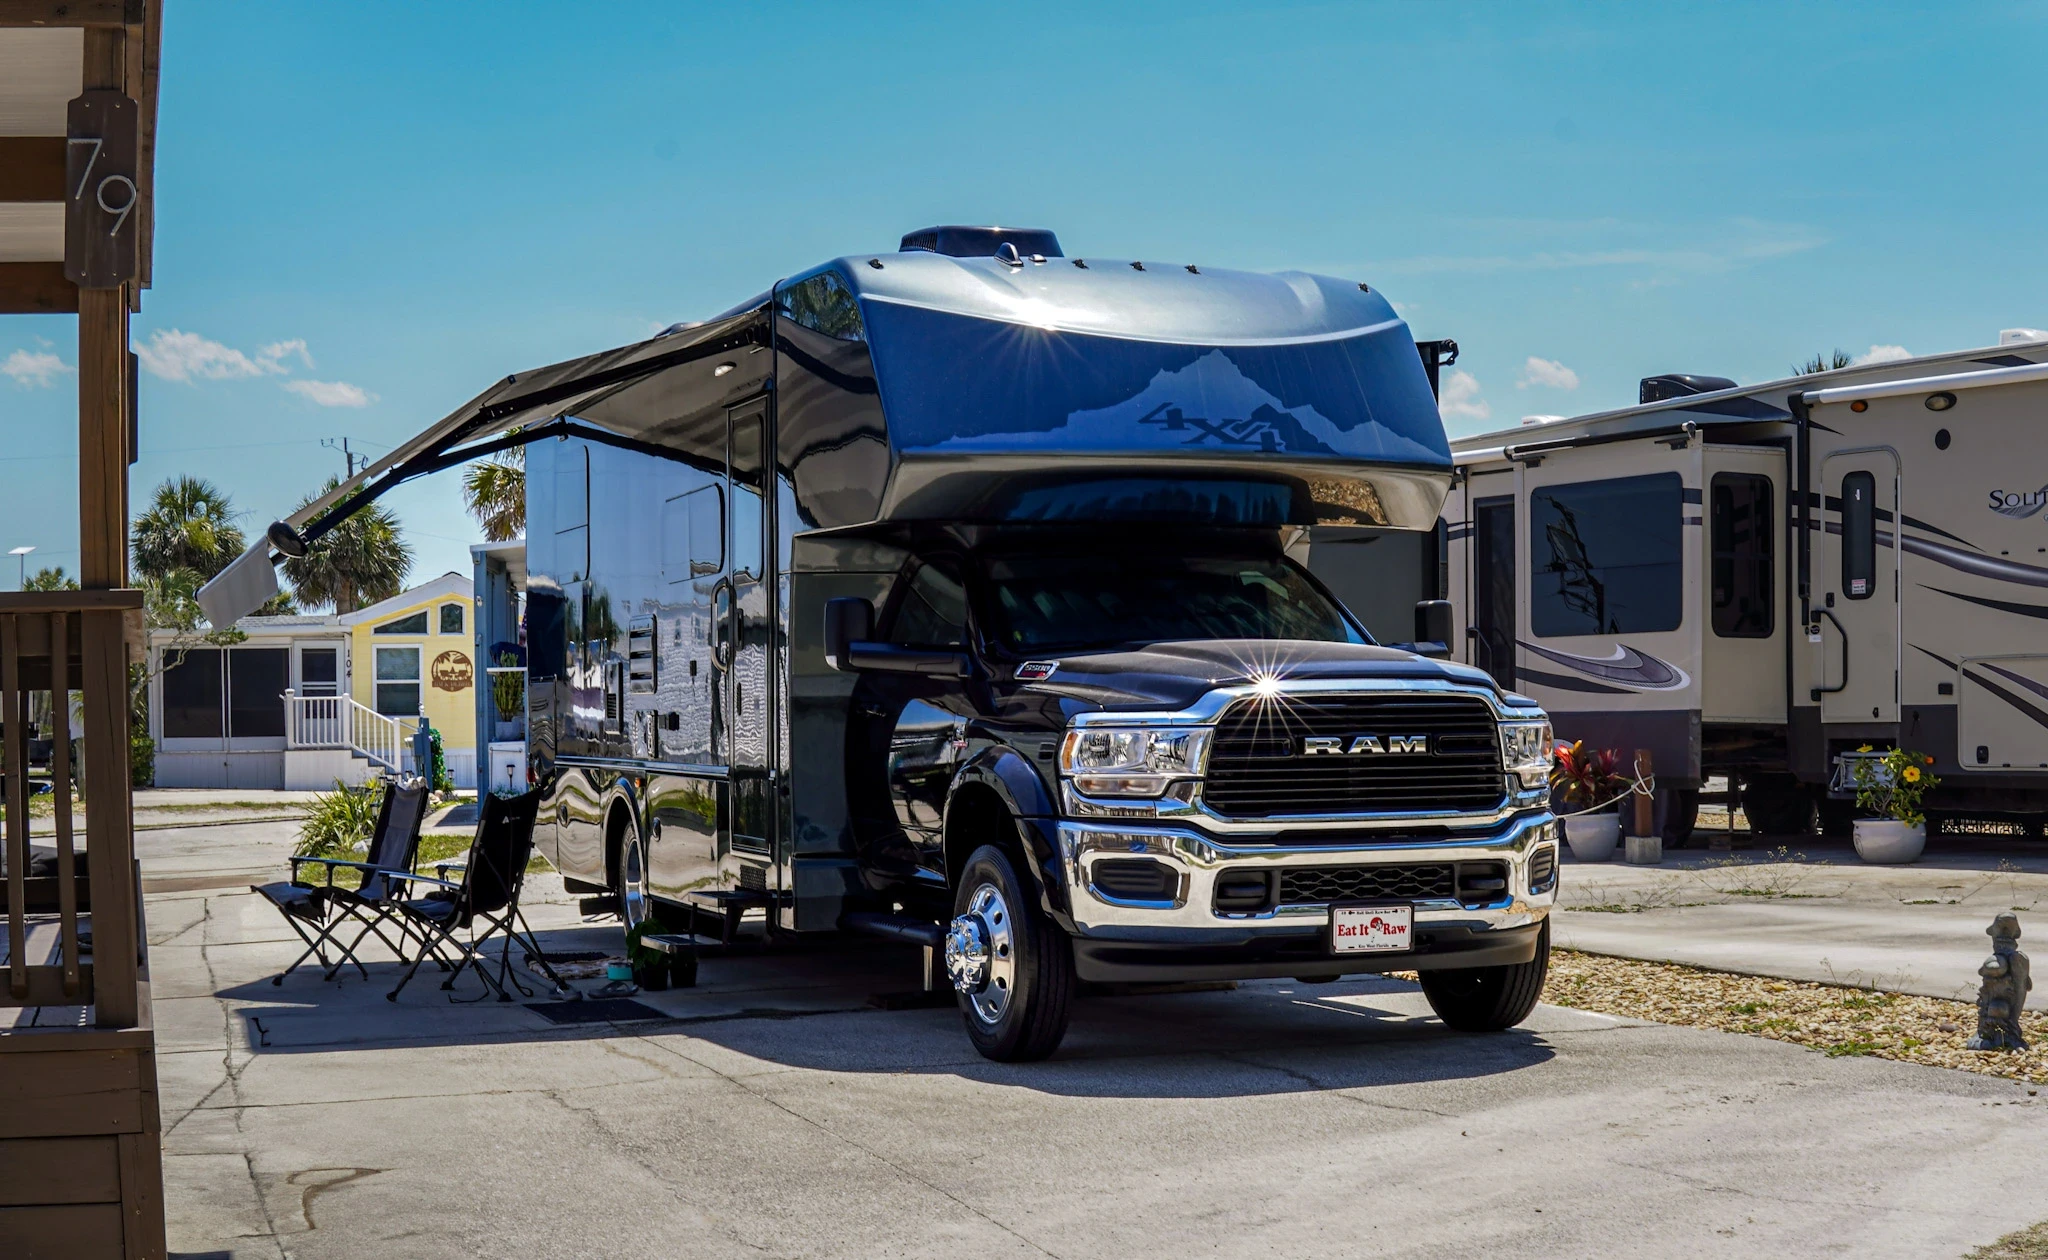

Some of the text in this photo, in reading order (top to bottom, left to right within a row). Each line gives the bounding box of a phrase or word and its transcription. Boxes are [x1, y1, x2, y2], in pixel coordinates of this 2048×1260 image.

[68, 138, 136, 236] 79
[1304, 736, 1427, 754] RAM
[1337, 923, 1407, 936] Eat It Raw
